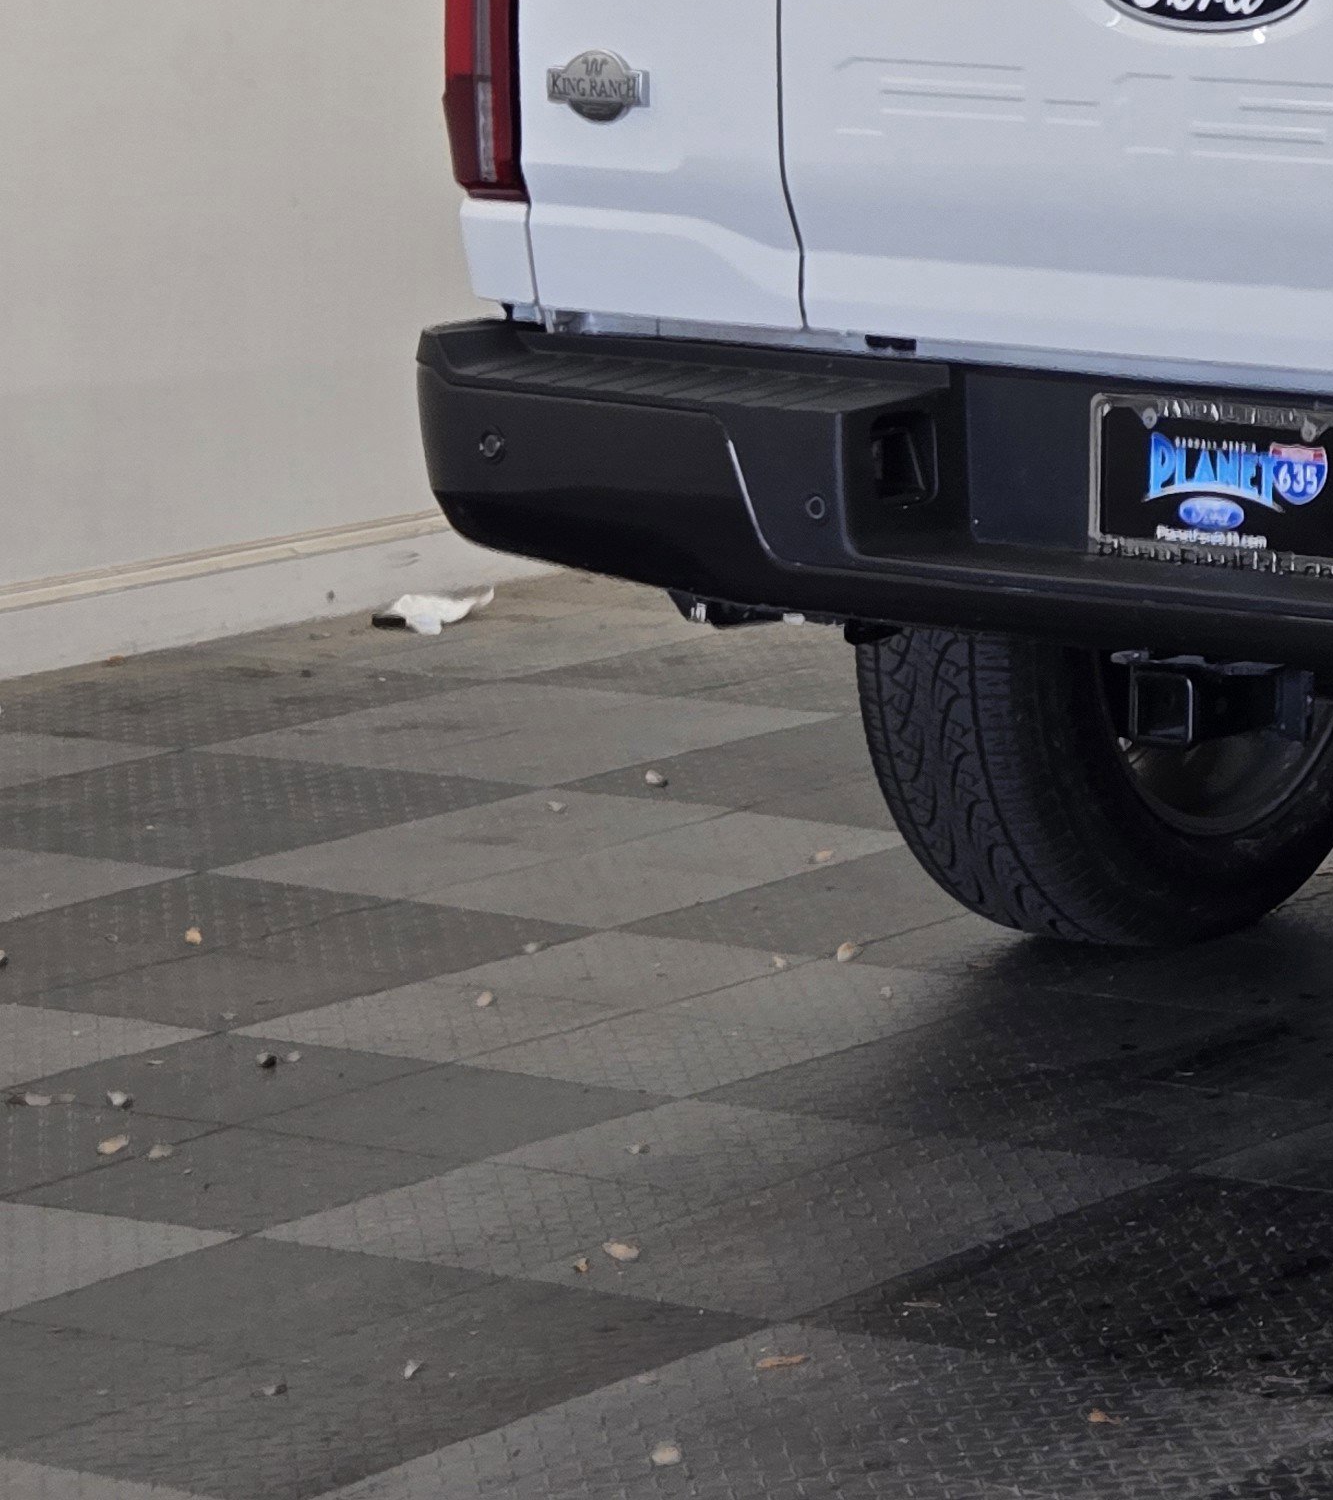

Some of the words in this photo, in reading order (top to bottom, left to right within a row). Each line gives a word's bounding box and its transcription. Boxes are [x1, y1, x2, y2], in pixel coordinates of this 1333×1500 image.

[551, 73, 586, 97] KING
[589, 77, 637, 99] RANCH
[1148, 431, 1279, 507] PLANET
[1277, 461, 1318, 495] 635
